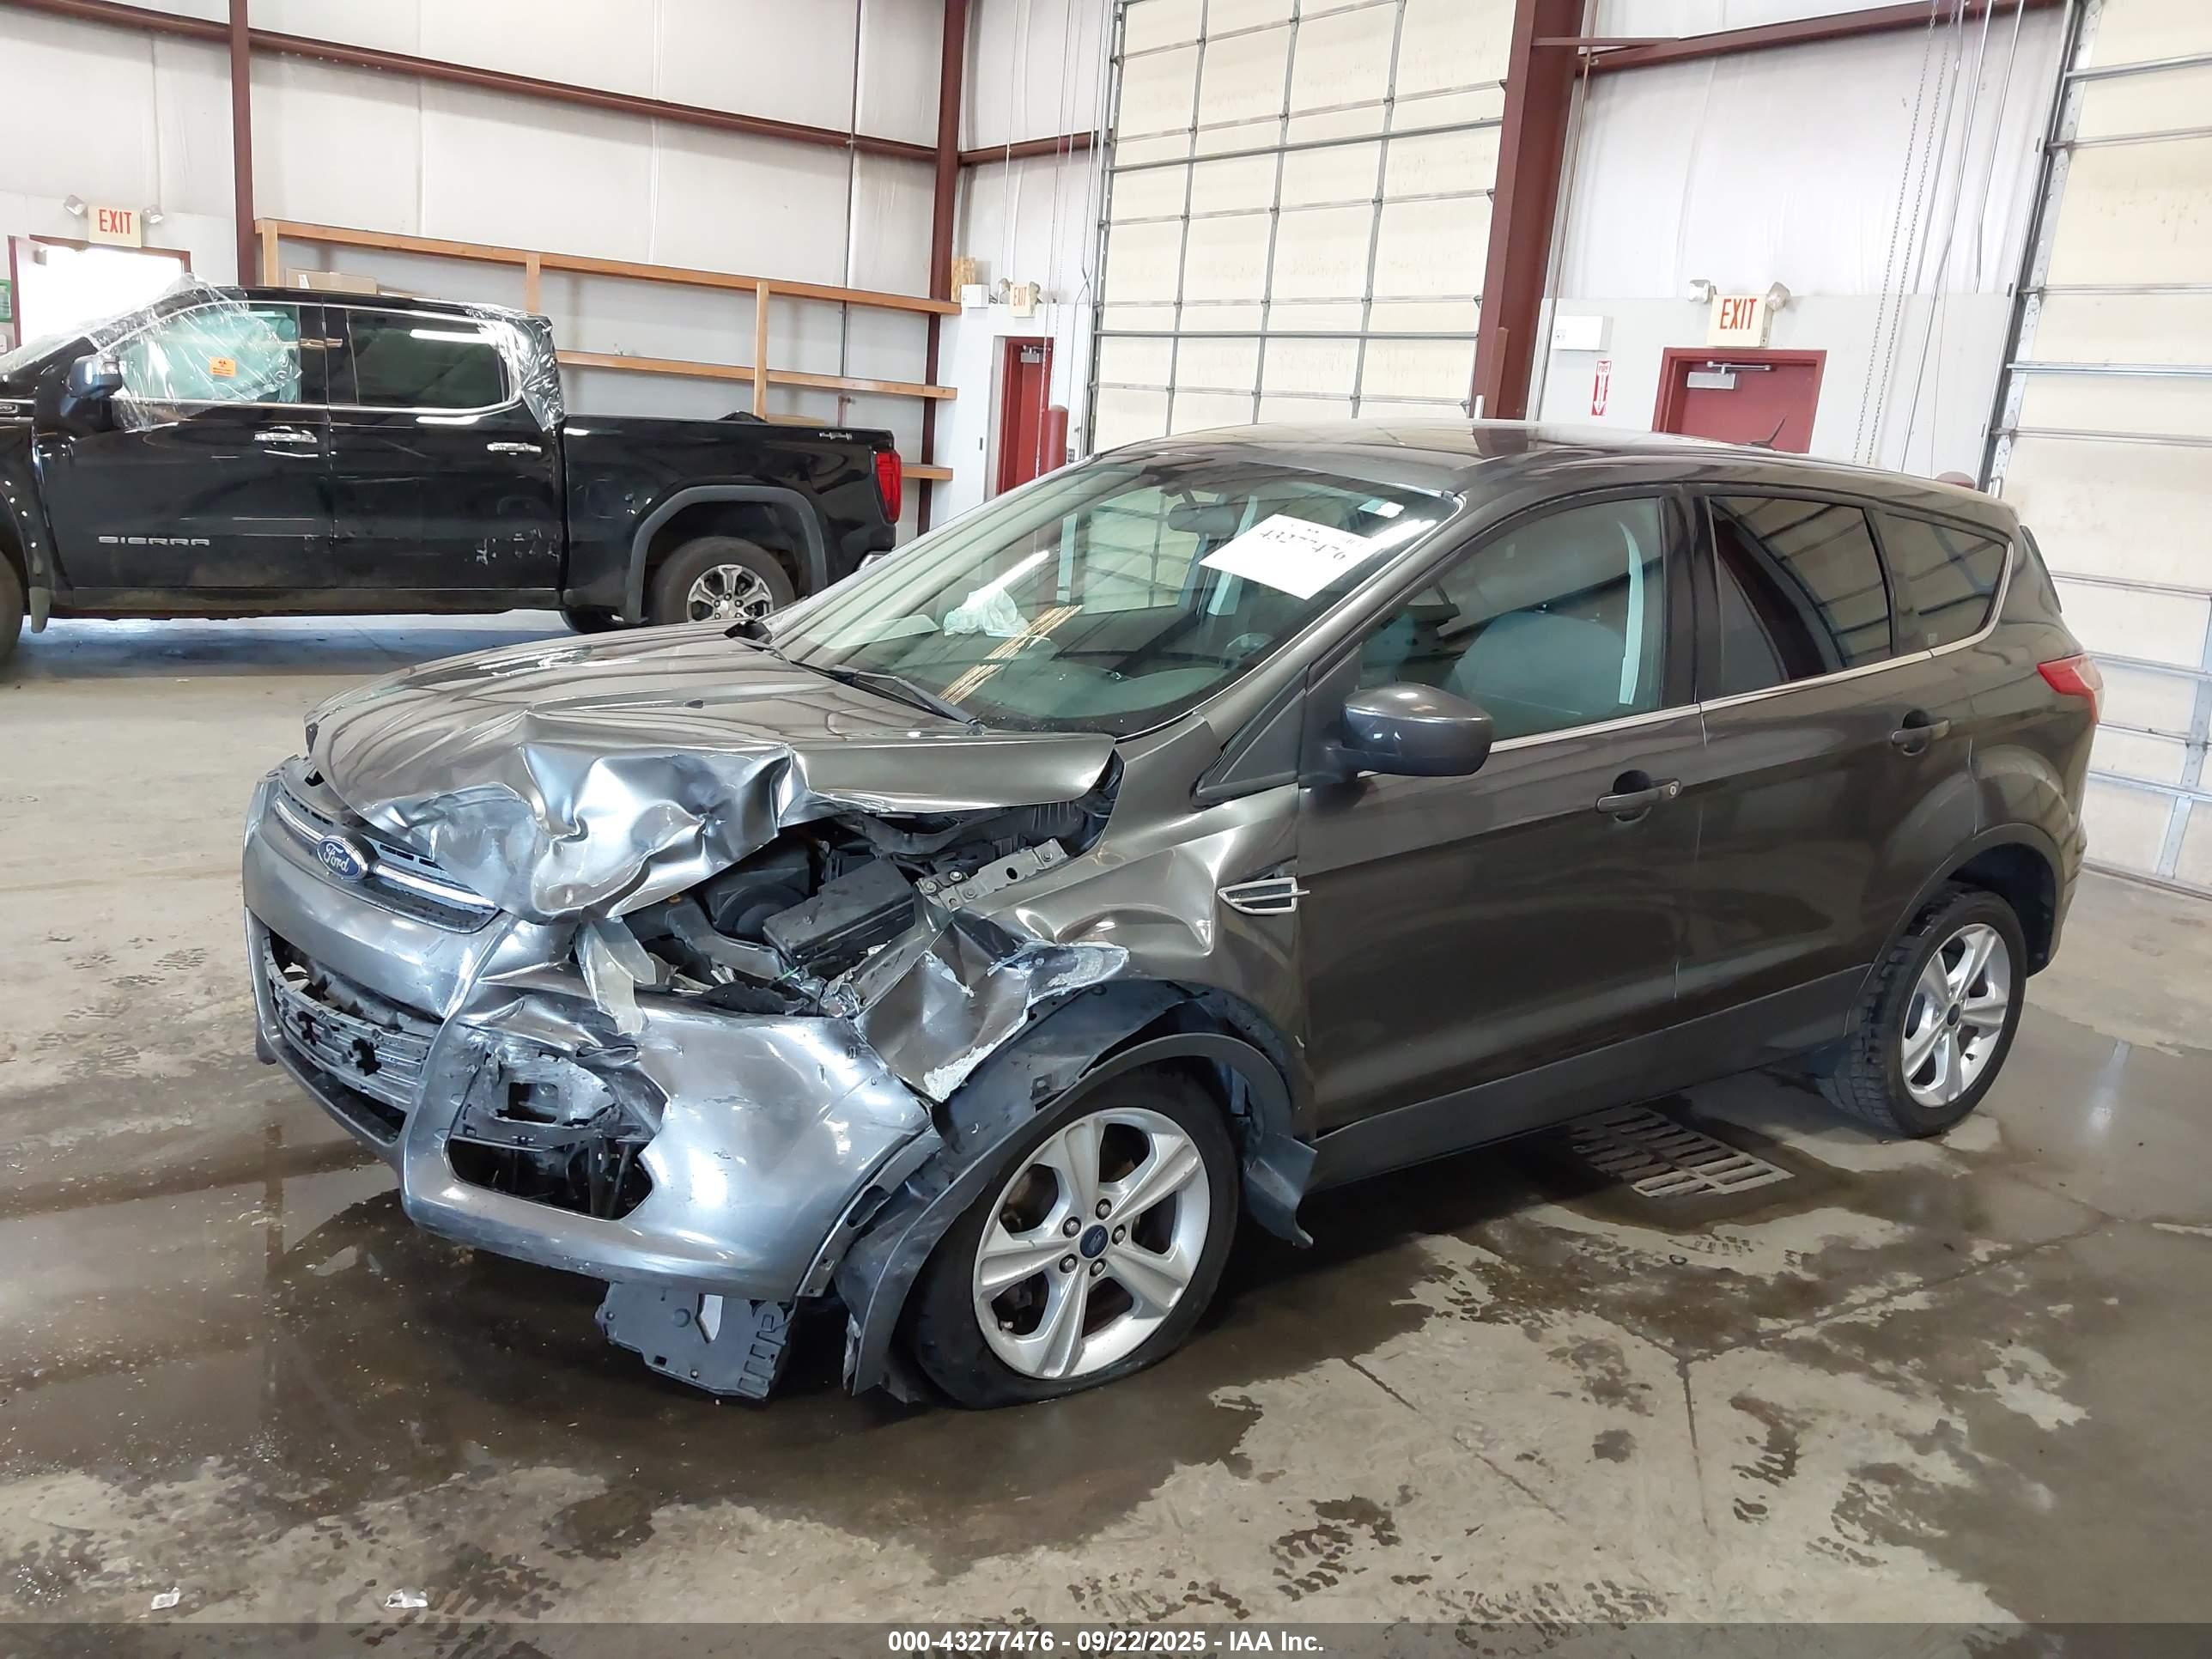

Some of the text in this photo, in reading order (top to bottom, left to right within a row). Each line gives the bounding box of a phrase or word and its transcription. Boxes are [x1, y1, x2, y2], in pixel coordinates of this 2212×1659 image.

[99, 209, 132, 234] EXIT
[1719, 298, 1757, 330] EXIT
[98, 536, 210, 546] SIERRA
[323, 842, 350, 873] Ford
